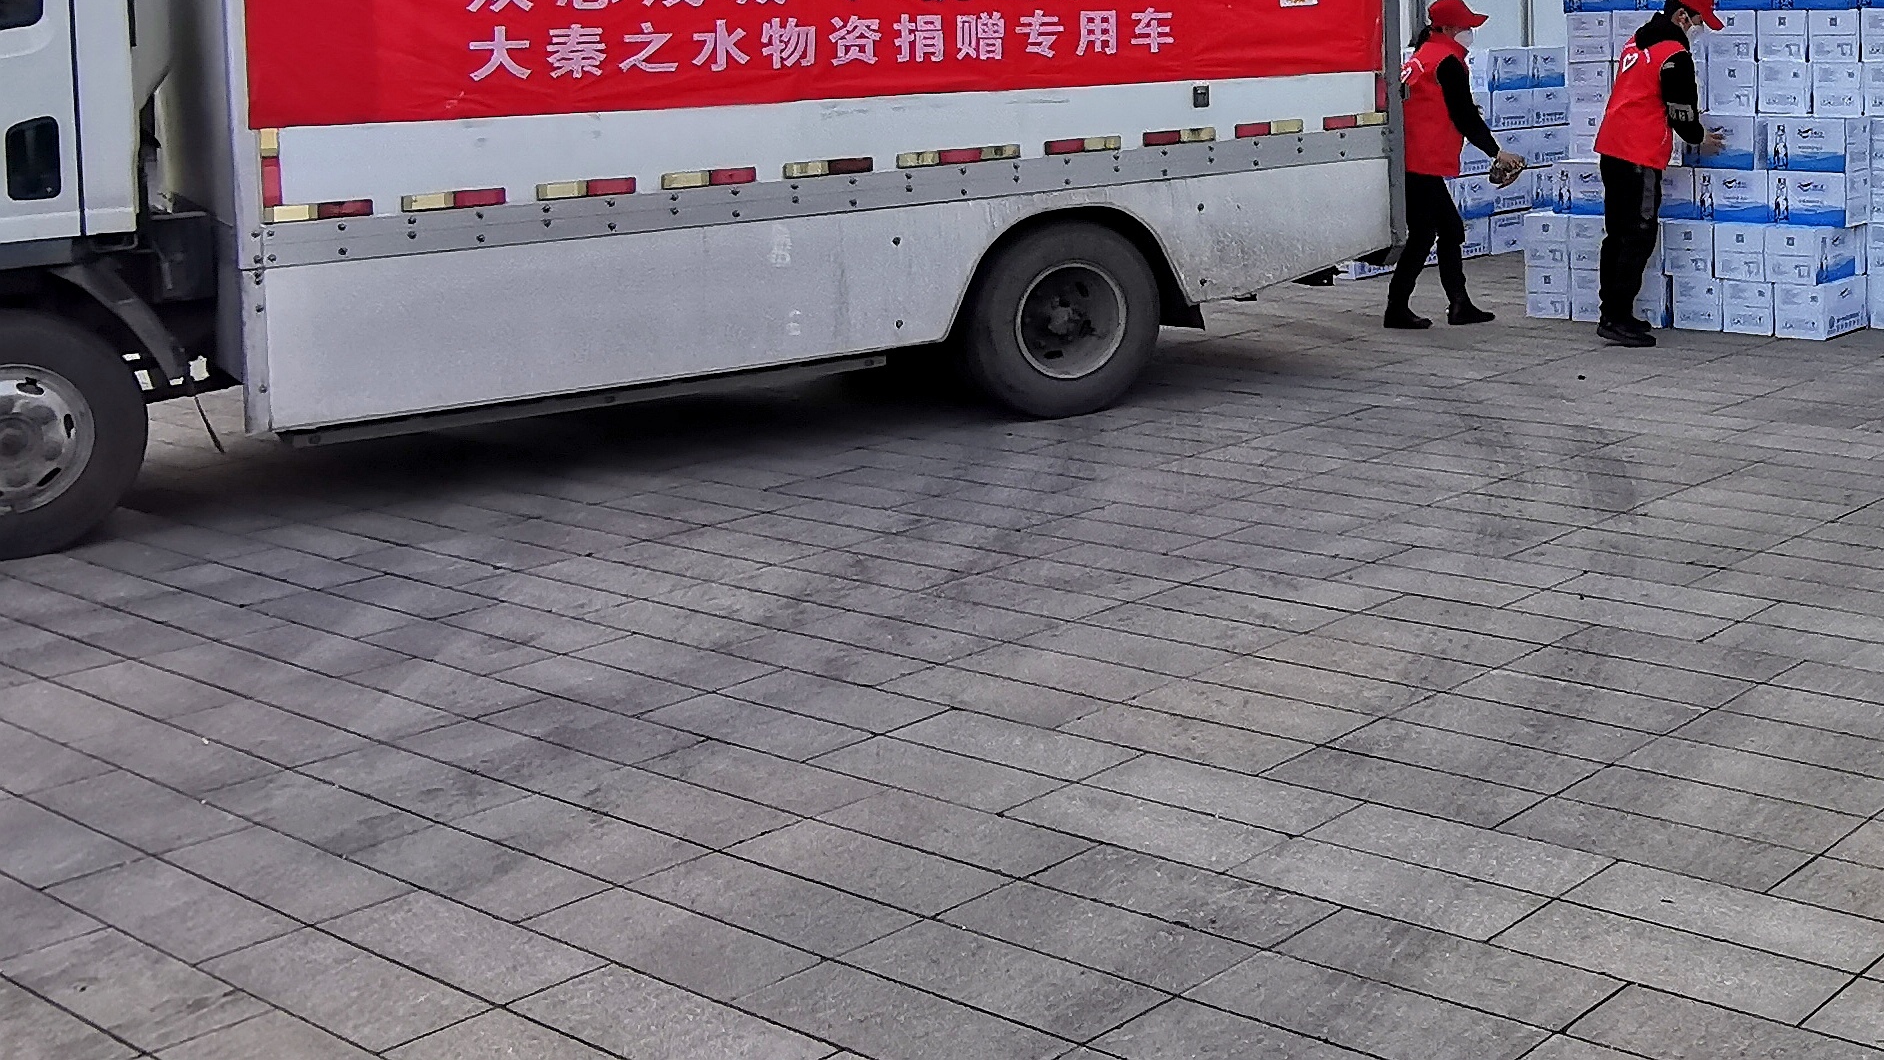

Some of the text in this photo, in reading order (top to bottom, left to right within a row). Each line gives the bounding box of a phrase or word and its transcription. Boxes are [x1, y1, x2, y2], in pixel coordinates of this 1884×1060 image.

[468, 7, 1175, 82] 大秦之水物资捐赠专用车
